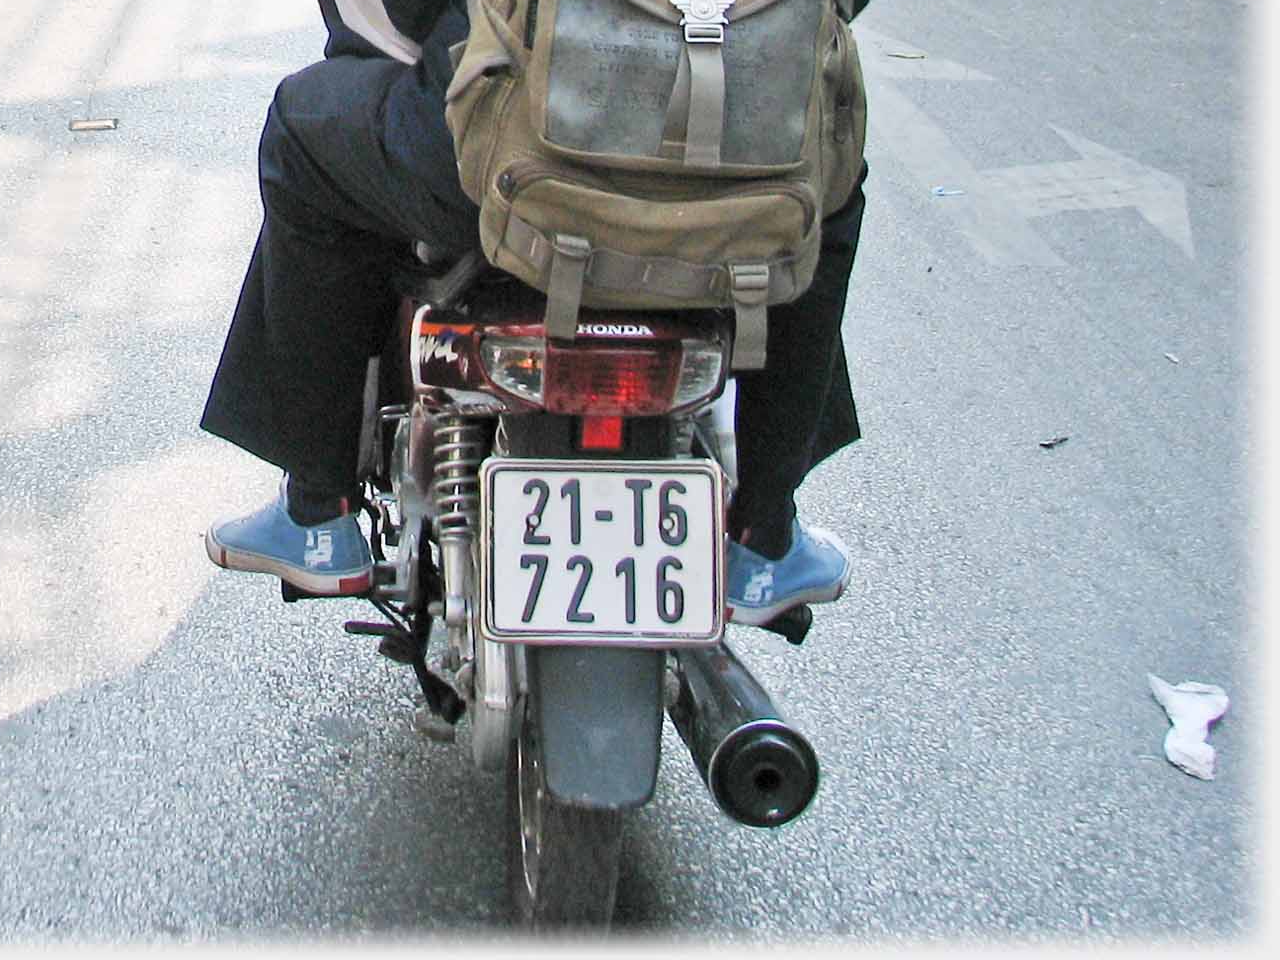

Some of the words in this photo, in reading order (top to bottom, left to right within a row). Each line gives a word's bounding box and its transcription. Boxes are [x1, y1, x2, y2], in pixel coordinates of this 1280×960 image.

[576, 324, 653, 335] HONDA
[522, 478, 688, 546] 21-T6
[520, 554, 685, 625] 7216
